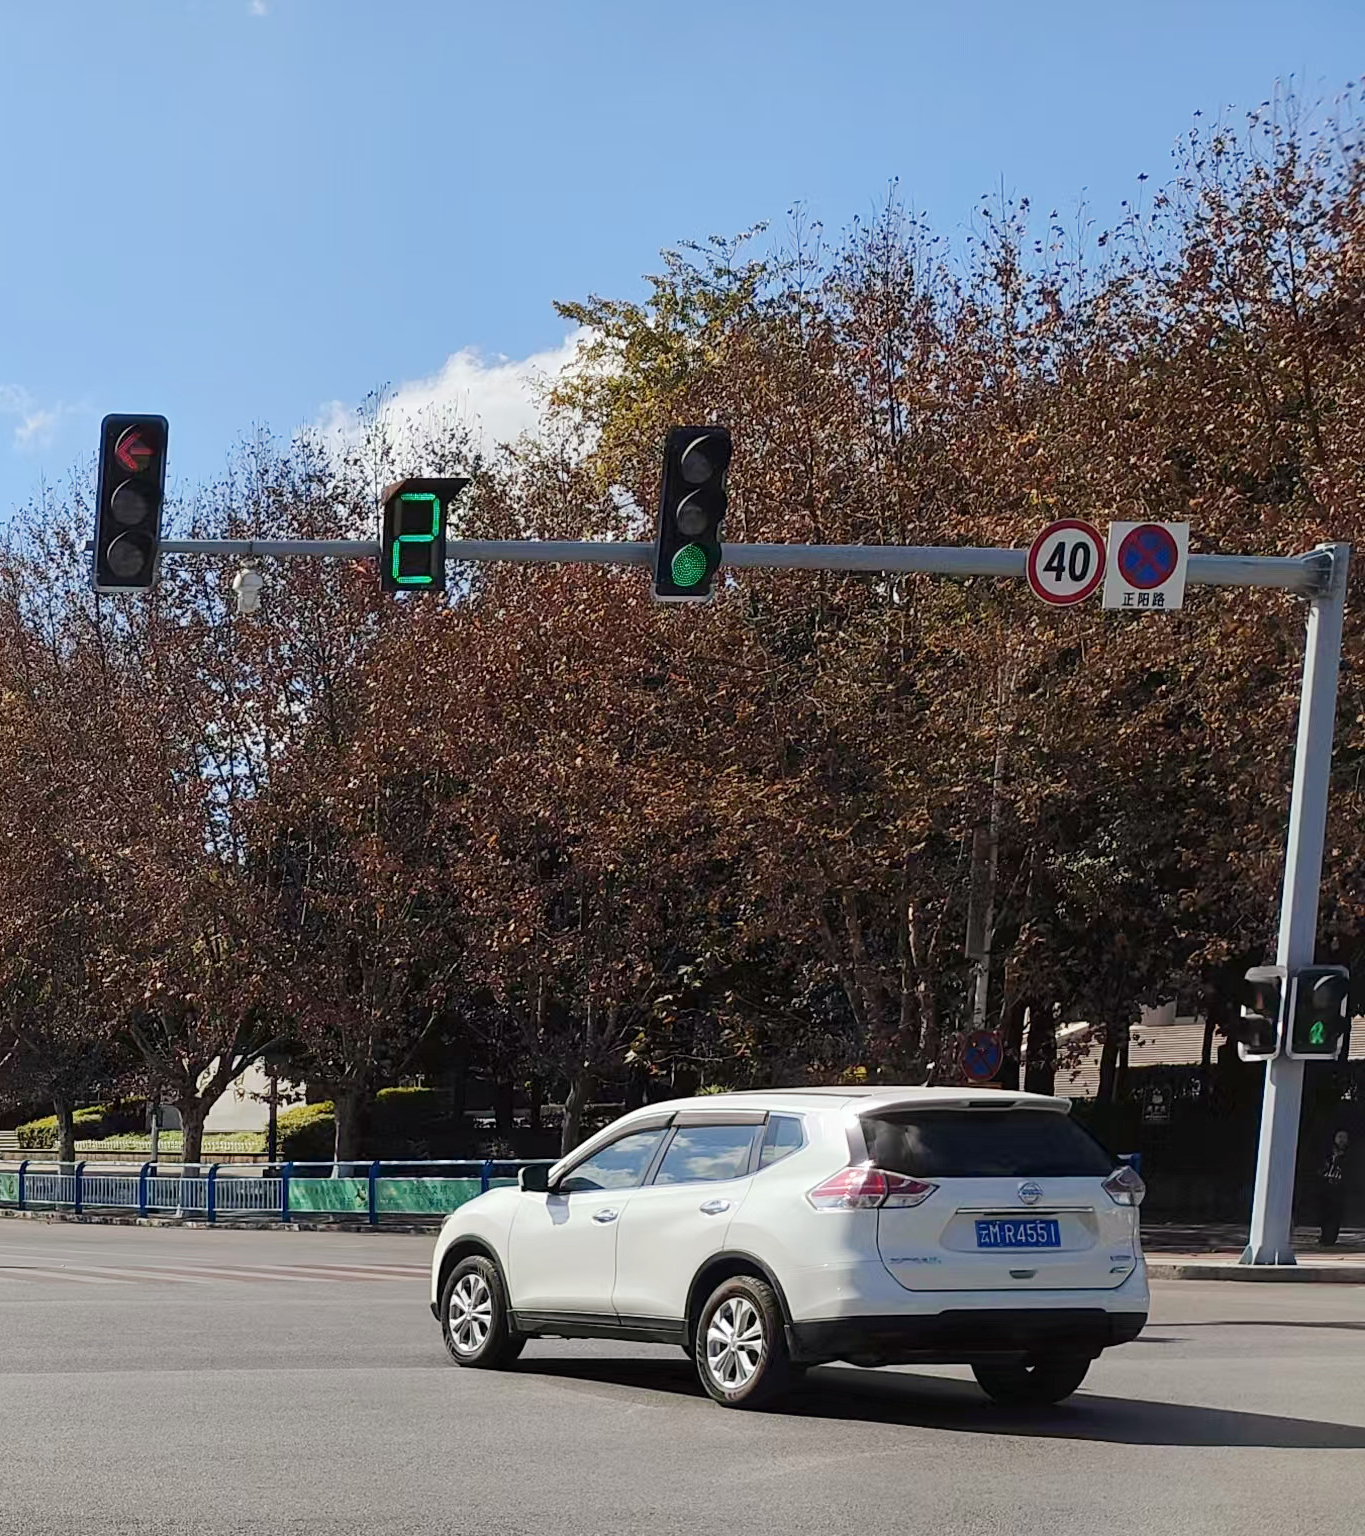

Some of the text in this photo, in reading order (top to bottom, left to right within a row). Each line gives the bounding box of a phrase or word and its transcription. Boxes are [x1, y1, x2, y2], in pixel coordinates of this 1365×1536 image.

[392, 493, 440, 584] 2
[1043, 541, 1091, 582] 40
[1121, 592, 1166, 607] 正阳路
